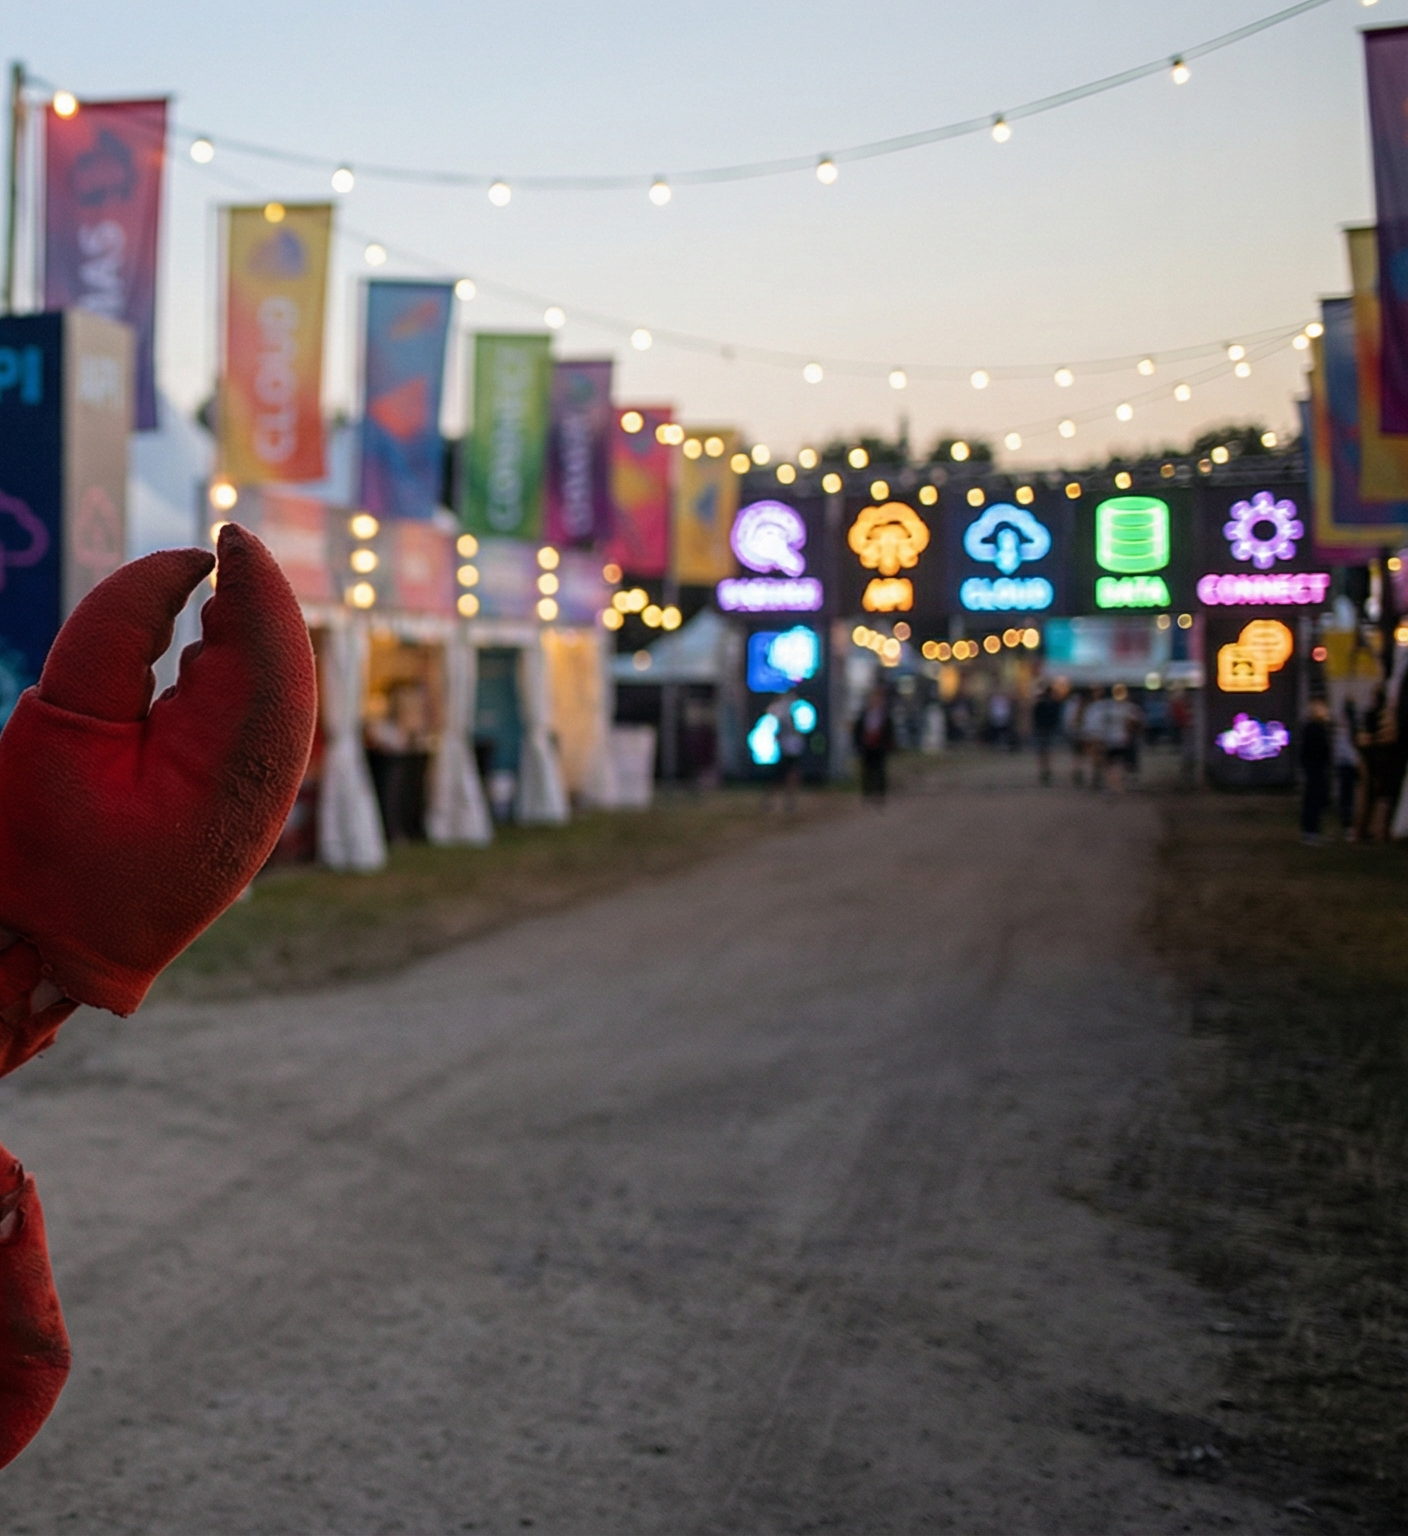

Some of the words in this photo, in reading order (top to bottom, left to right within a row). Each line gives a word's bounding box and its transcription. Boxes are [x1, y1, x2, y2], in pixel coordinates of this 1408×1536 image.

[254, 295, 301, 463] CLOUD
[960, 577, 1053, 610] CLOUD
[1096, 576, 1171, 608] DATA
[1197, 573, 1331, 605] CONNECT
